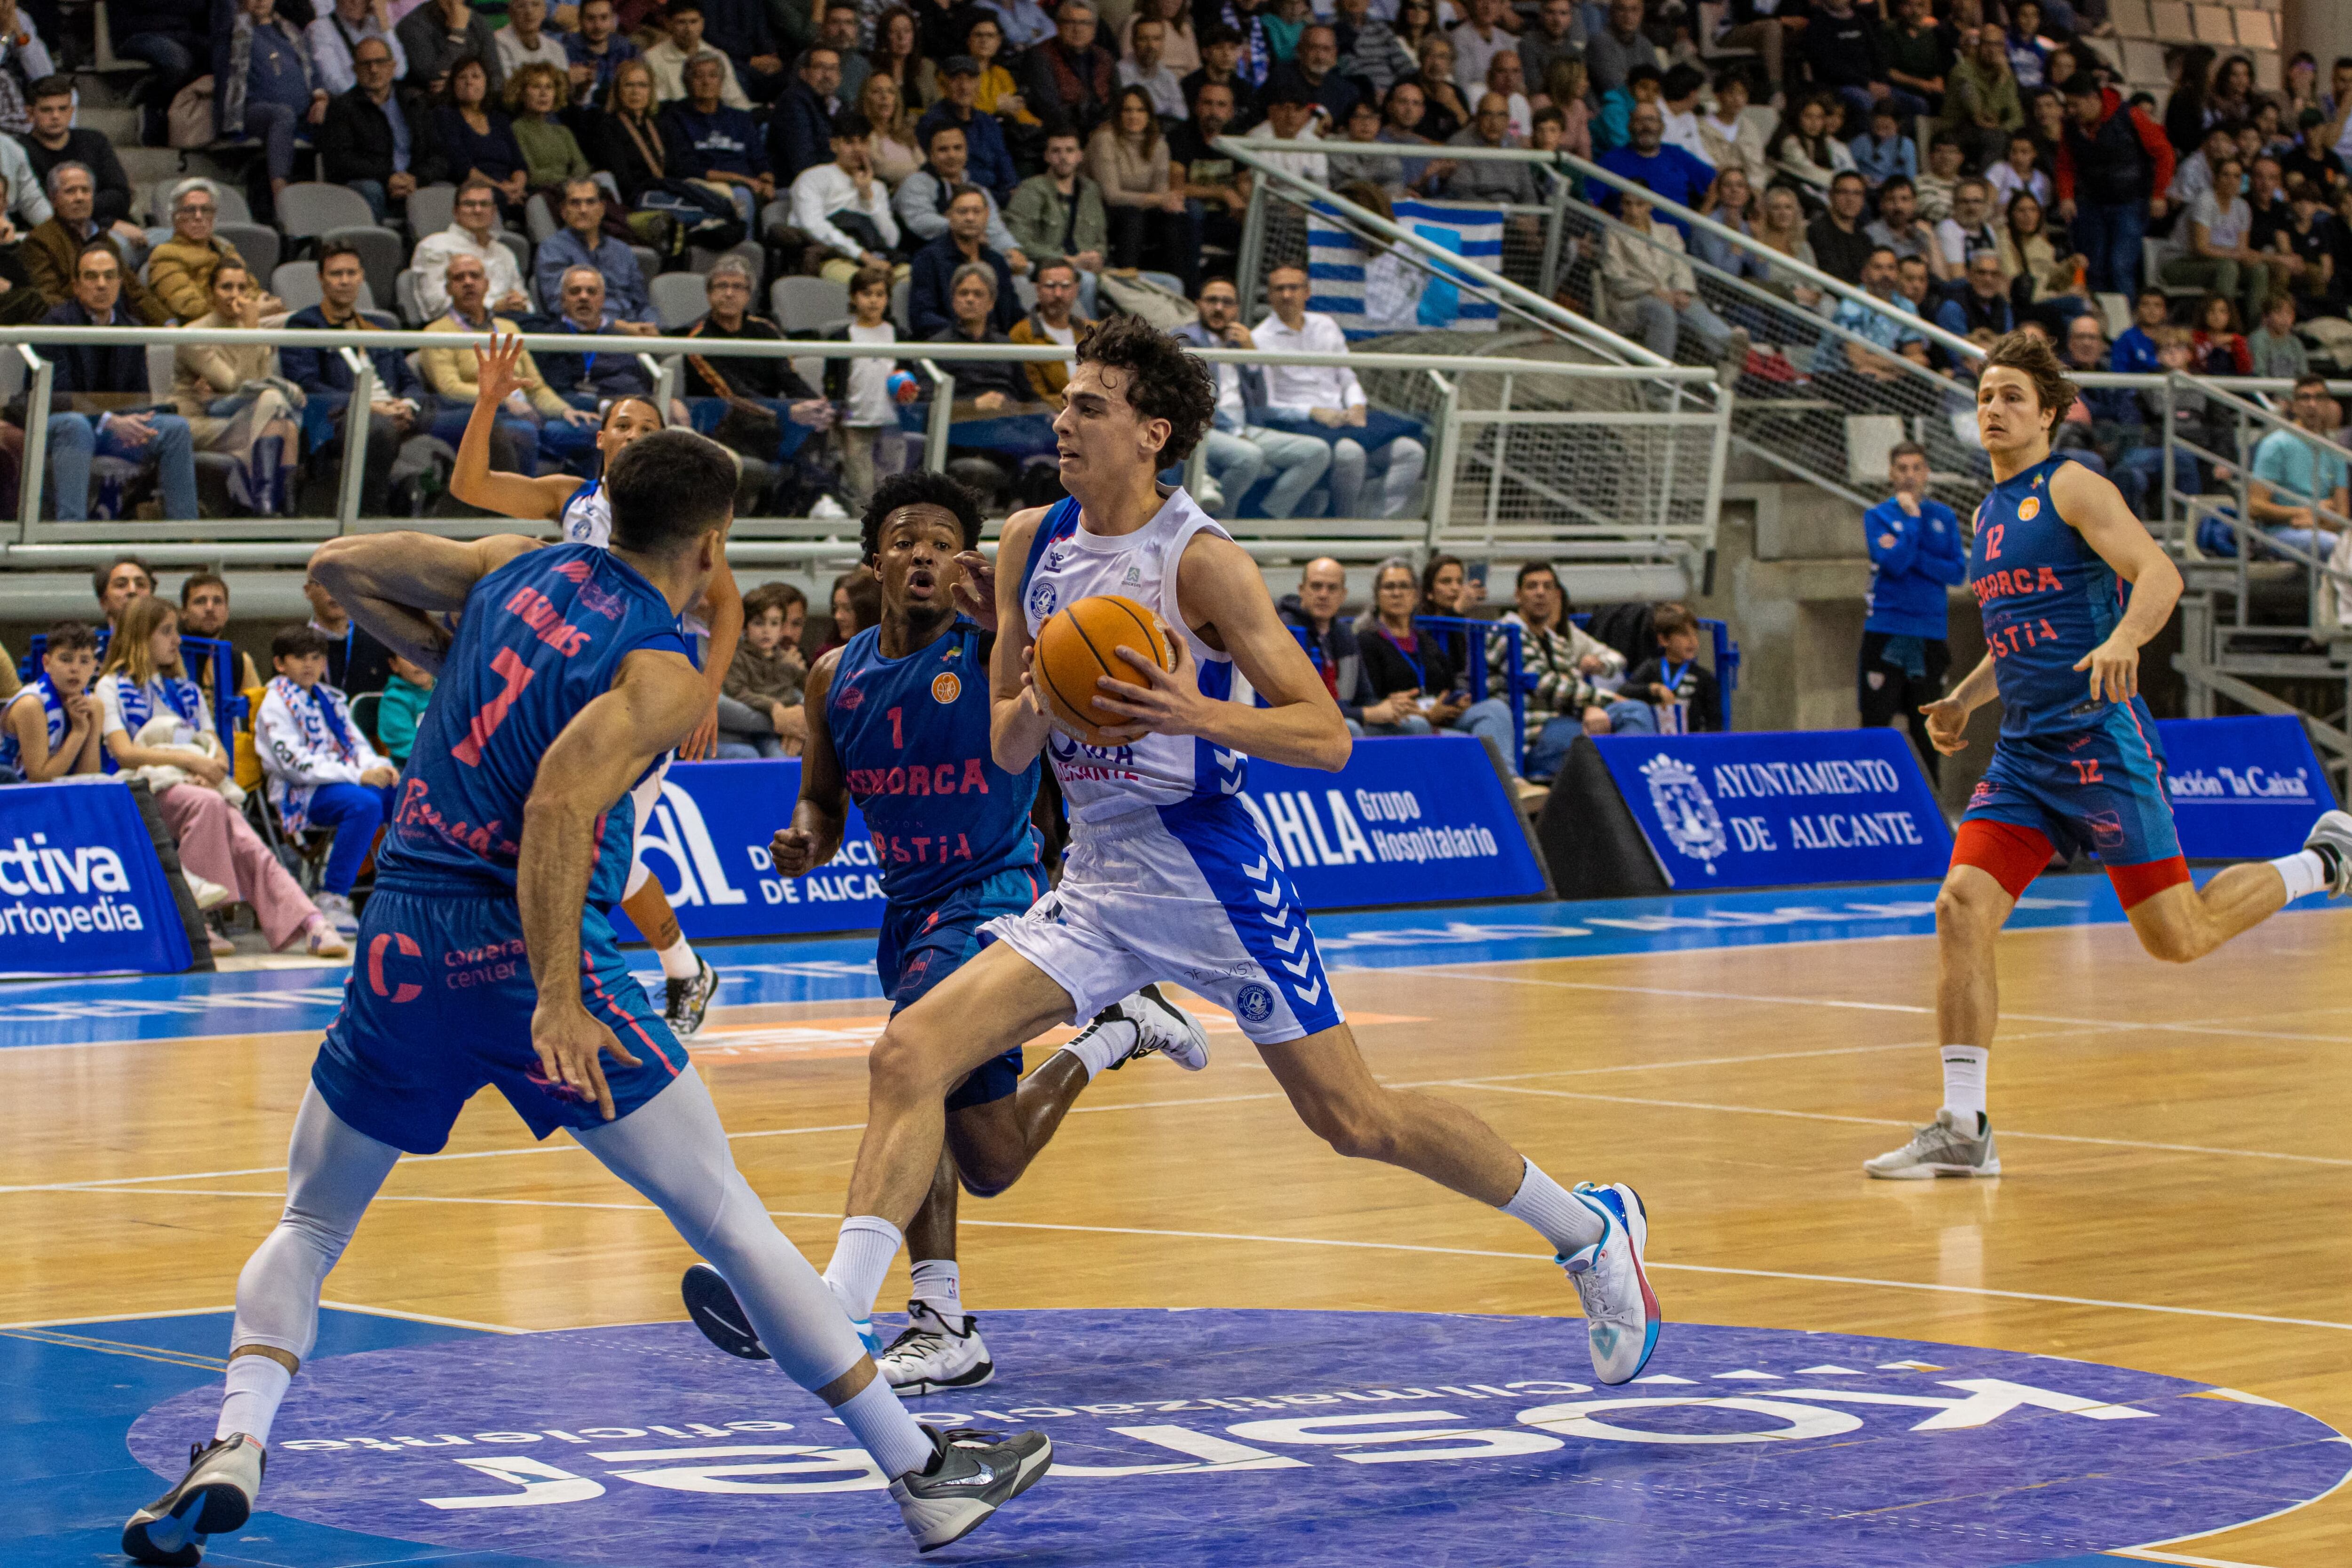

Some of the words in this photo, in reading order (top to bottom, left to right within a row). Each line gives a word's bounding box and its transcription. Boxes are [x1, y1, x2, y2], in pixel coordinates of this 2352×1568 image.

[1986, 524, 2004, 561] 12
[452, 646, 535, 768] 7
[887, 707, 904, 749] 1
[1713, 758, 1899, 798] AYUNTAMIENTO
[2071, 758, 2104, 785] 12
[1355, 788, 1422, 823] Grupo
[1263, 789, 1376, 867] HLA
[1370, 823, 1499, 865] Hospitalario
[1729, 816, 1777, 852] DE
[1789, 811, 1923, 849] ALICANTE
[759, 876, 801, 905] DE
[806, 872, 890, 903] ALICA
[445, 960, 517, 989] center
[1240, 987, 1265, 998] LUCENTUM
[1246, 1010, 1270, 1020] ALICANTE
[822, 1381, 1594, 1426] Climatizació
[279, 1420, 795, 1451] eficiente
